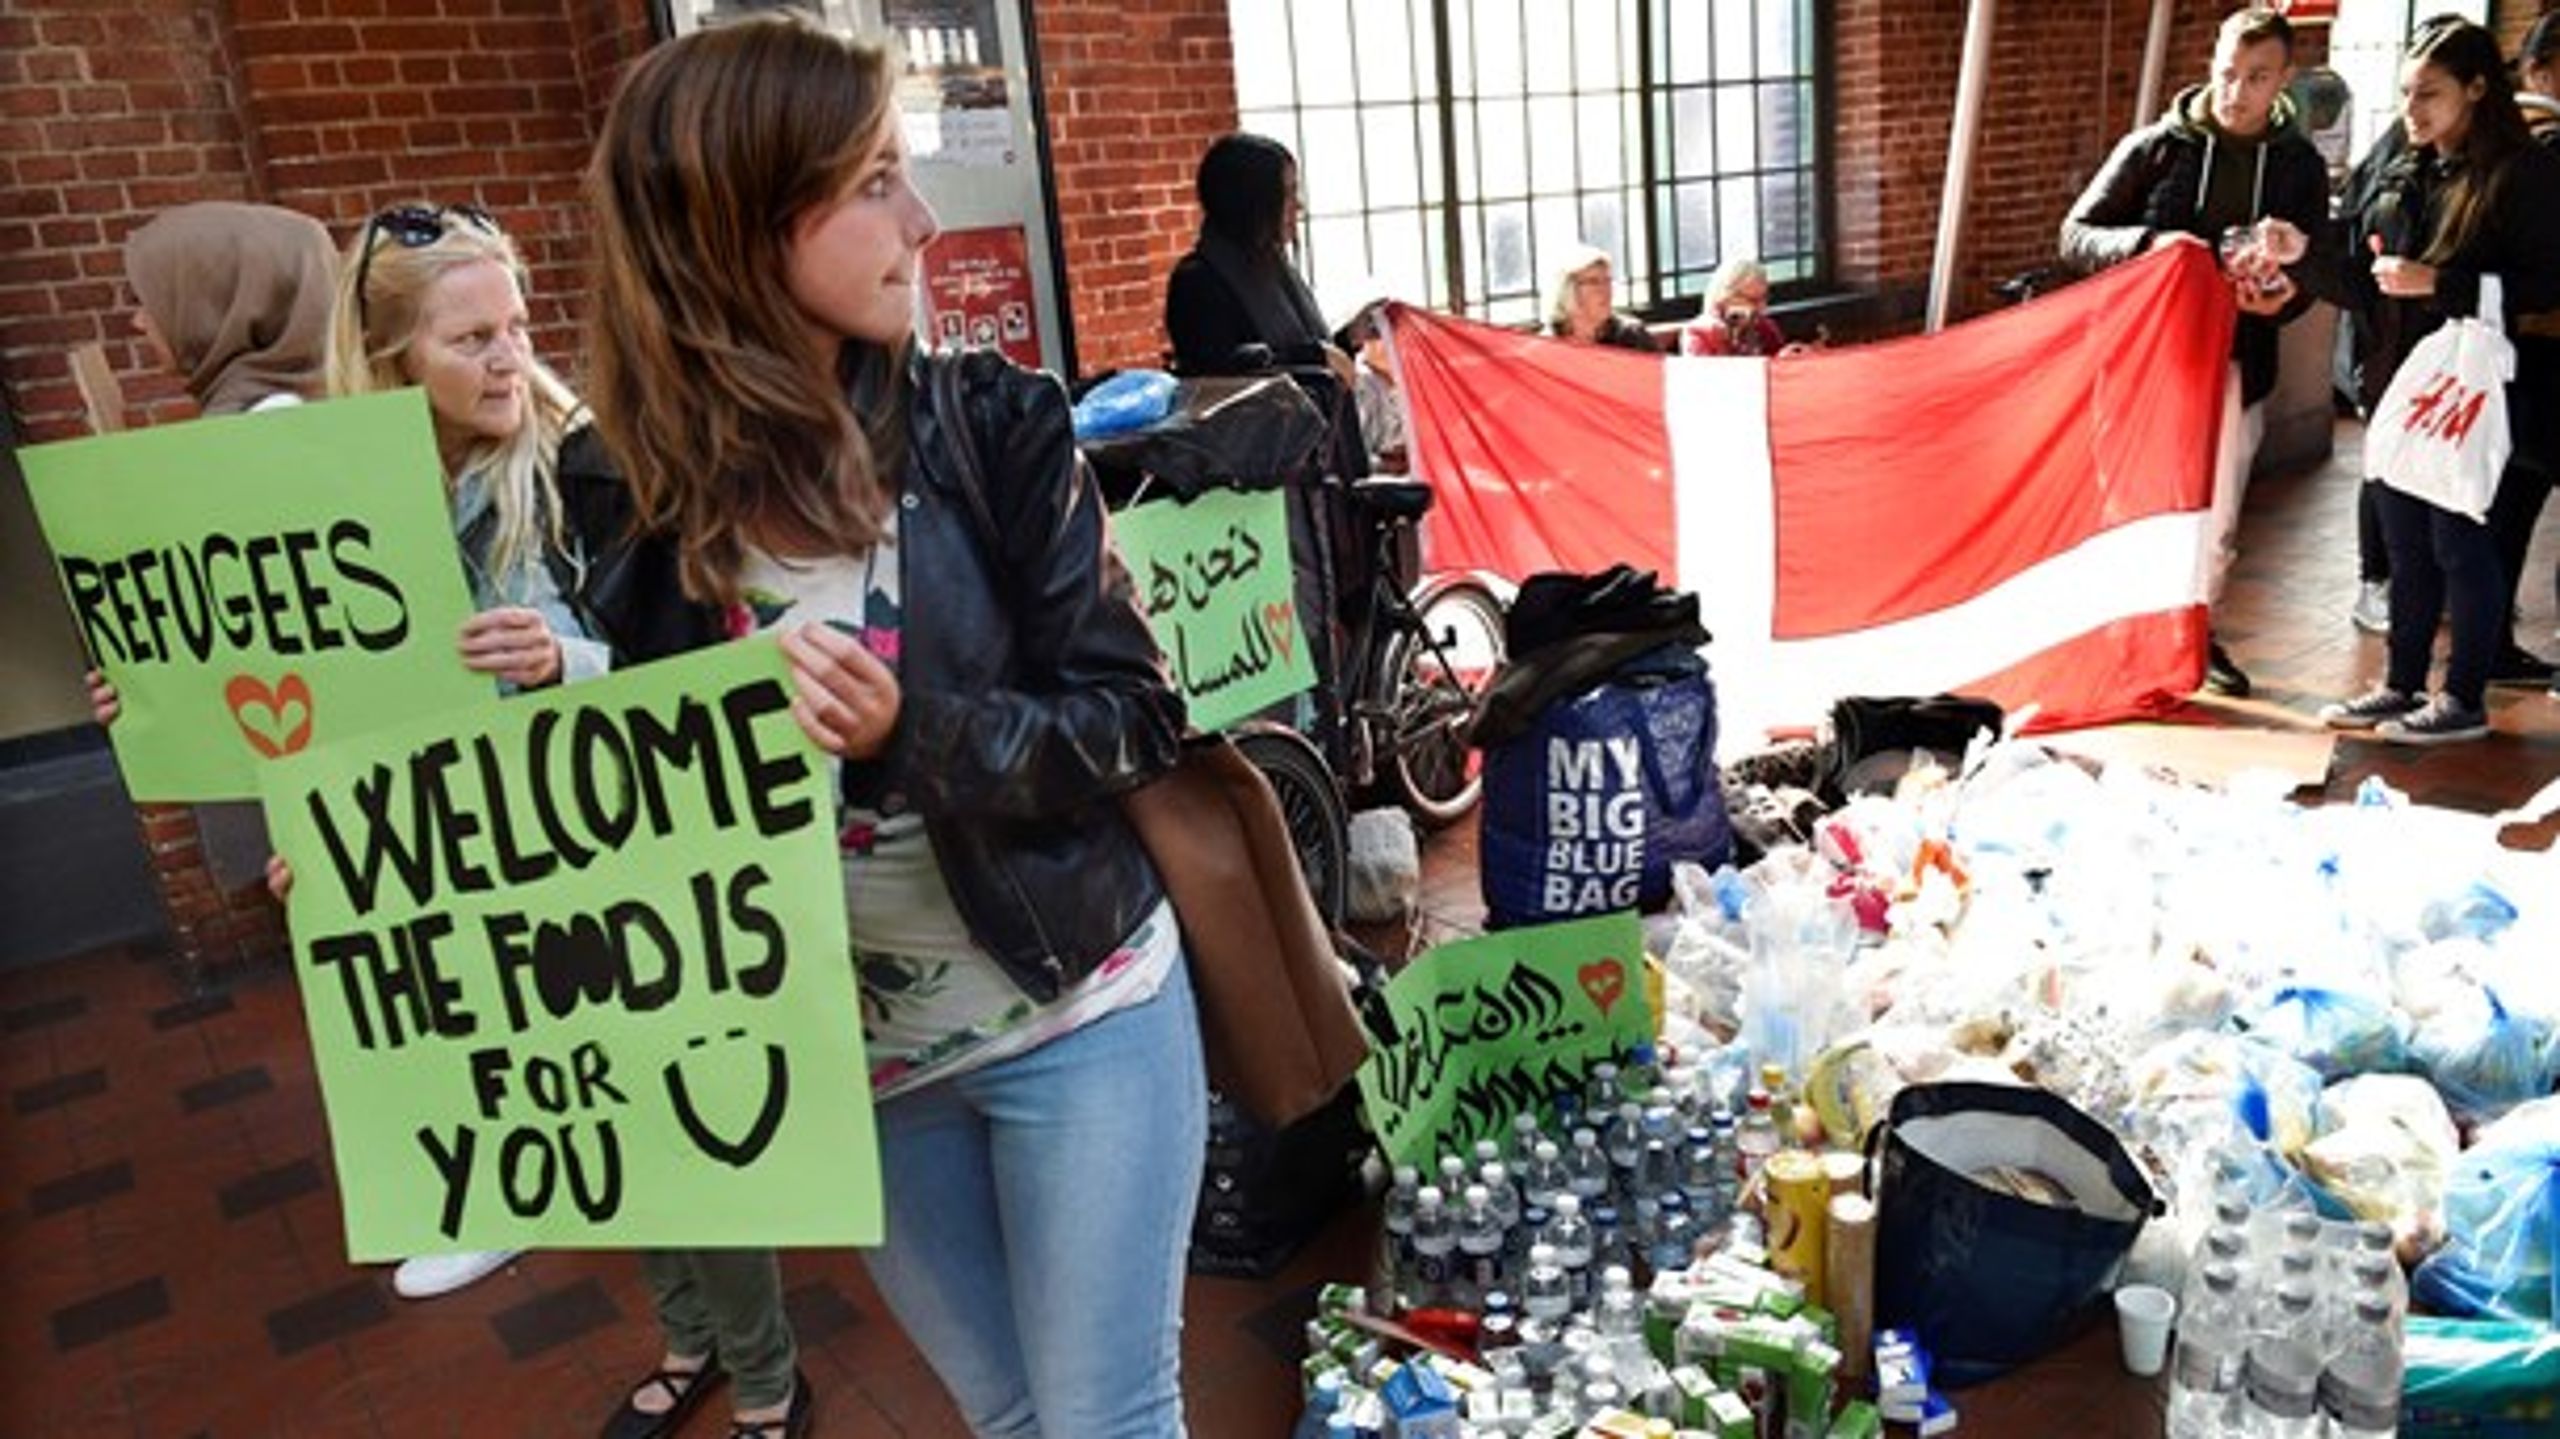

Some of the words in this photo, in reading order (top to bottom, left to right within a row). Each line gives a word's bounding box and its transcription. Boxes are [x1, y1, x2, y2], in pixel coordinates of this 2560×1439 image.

[62, 520, 408, 672] REFUGEES
[307, 679, 814, 915] WELCOME
[1548, 737, 1641, 789] MY
[1548, 792, 1645, 839] BIG
[1543, 872, 1641, 913] BAG
[1547, 838, 1645, 874] BLUE
[310, 912, 476, 1049] THE
[483, 901, 682, 1032] FOOD
[691, 864, 787, 997] IS
[470, 1041, 629, 1119] FOR
[418, 1120, 622, 1239] YOU
